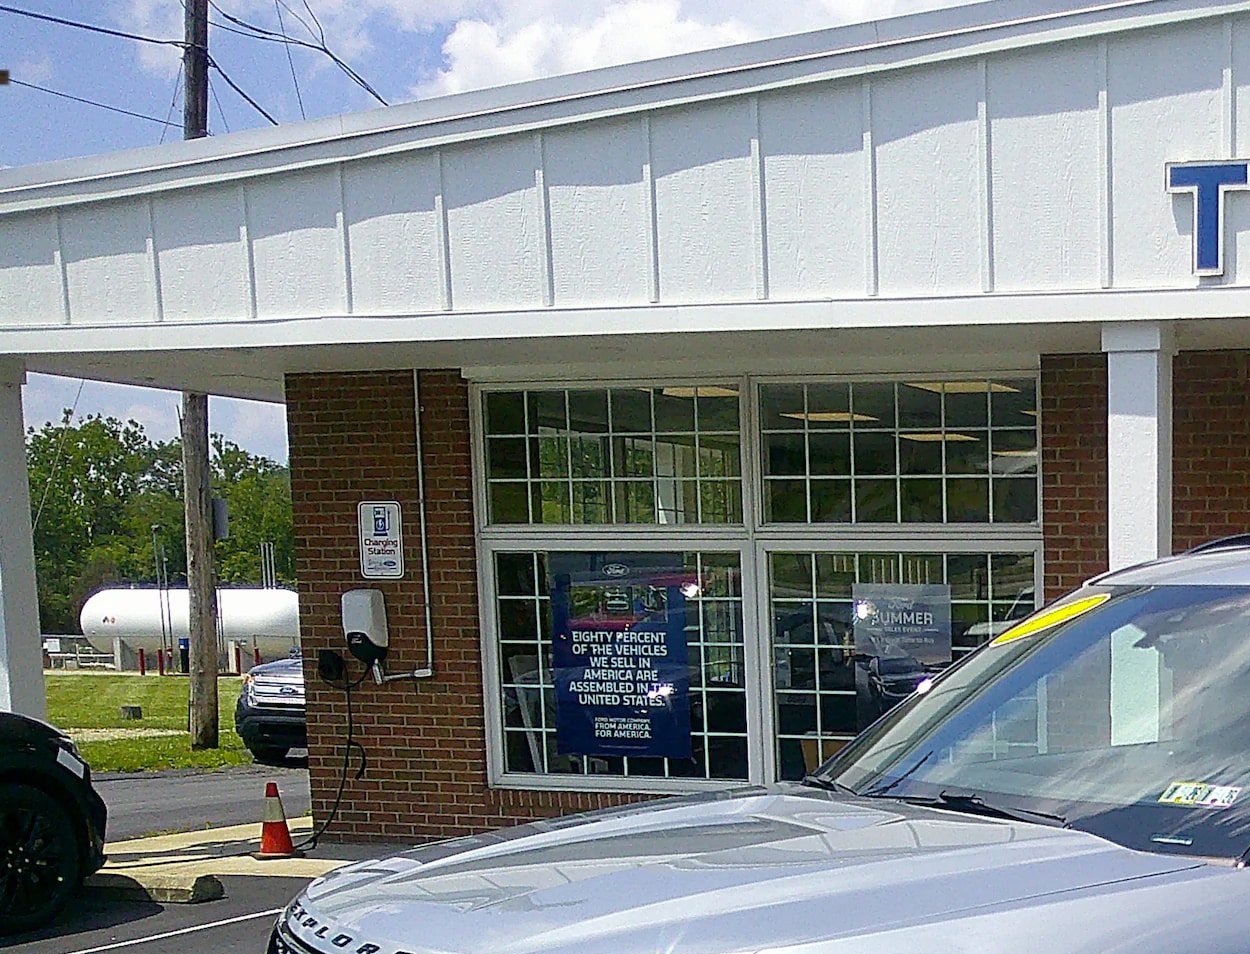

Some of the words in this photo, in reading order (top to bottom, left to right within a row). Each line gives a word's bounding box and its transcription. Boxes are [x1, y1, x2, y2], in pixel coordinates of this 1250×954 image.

[364, 538, 398, 547] Charging
[368, 547, 396, 555] Station
[572, 631, 613, 642] EIGHTY
[616, 632, 666, 643] PERCENT
[572, 644, 588, 654] OF
[590, 644, 612, 655] THE
[615, 644, 668, 656] VEHICLES
[590, 656, 609, 668] WE
[610, 657, 636, 668] SELL
[639, 658, 651, 668] IN
[583, 669, 632, 680] AMERICA
[635, 670, 659, 681] ARE
[569, 681, 634, 693] ASSEMBLED
[636, 682, 648, 693] IN
[579, 694, 621, 705] UNITED
[623, 695, 666, 706] STATES.
[618, 723, 651, 731] AMERICA.
[595, 730, 612, 738] FOR
[614, 730, 652, 738] AMERICA.
